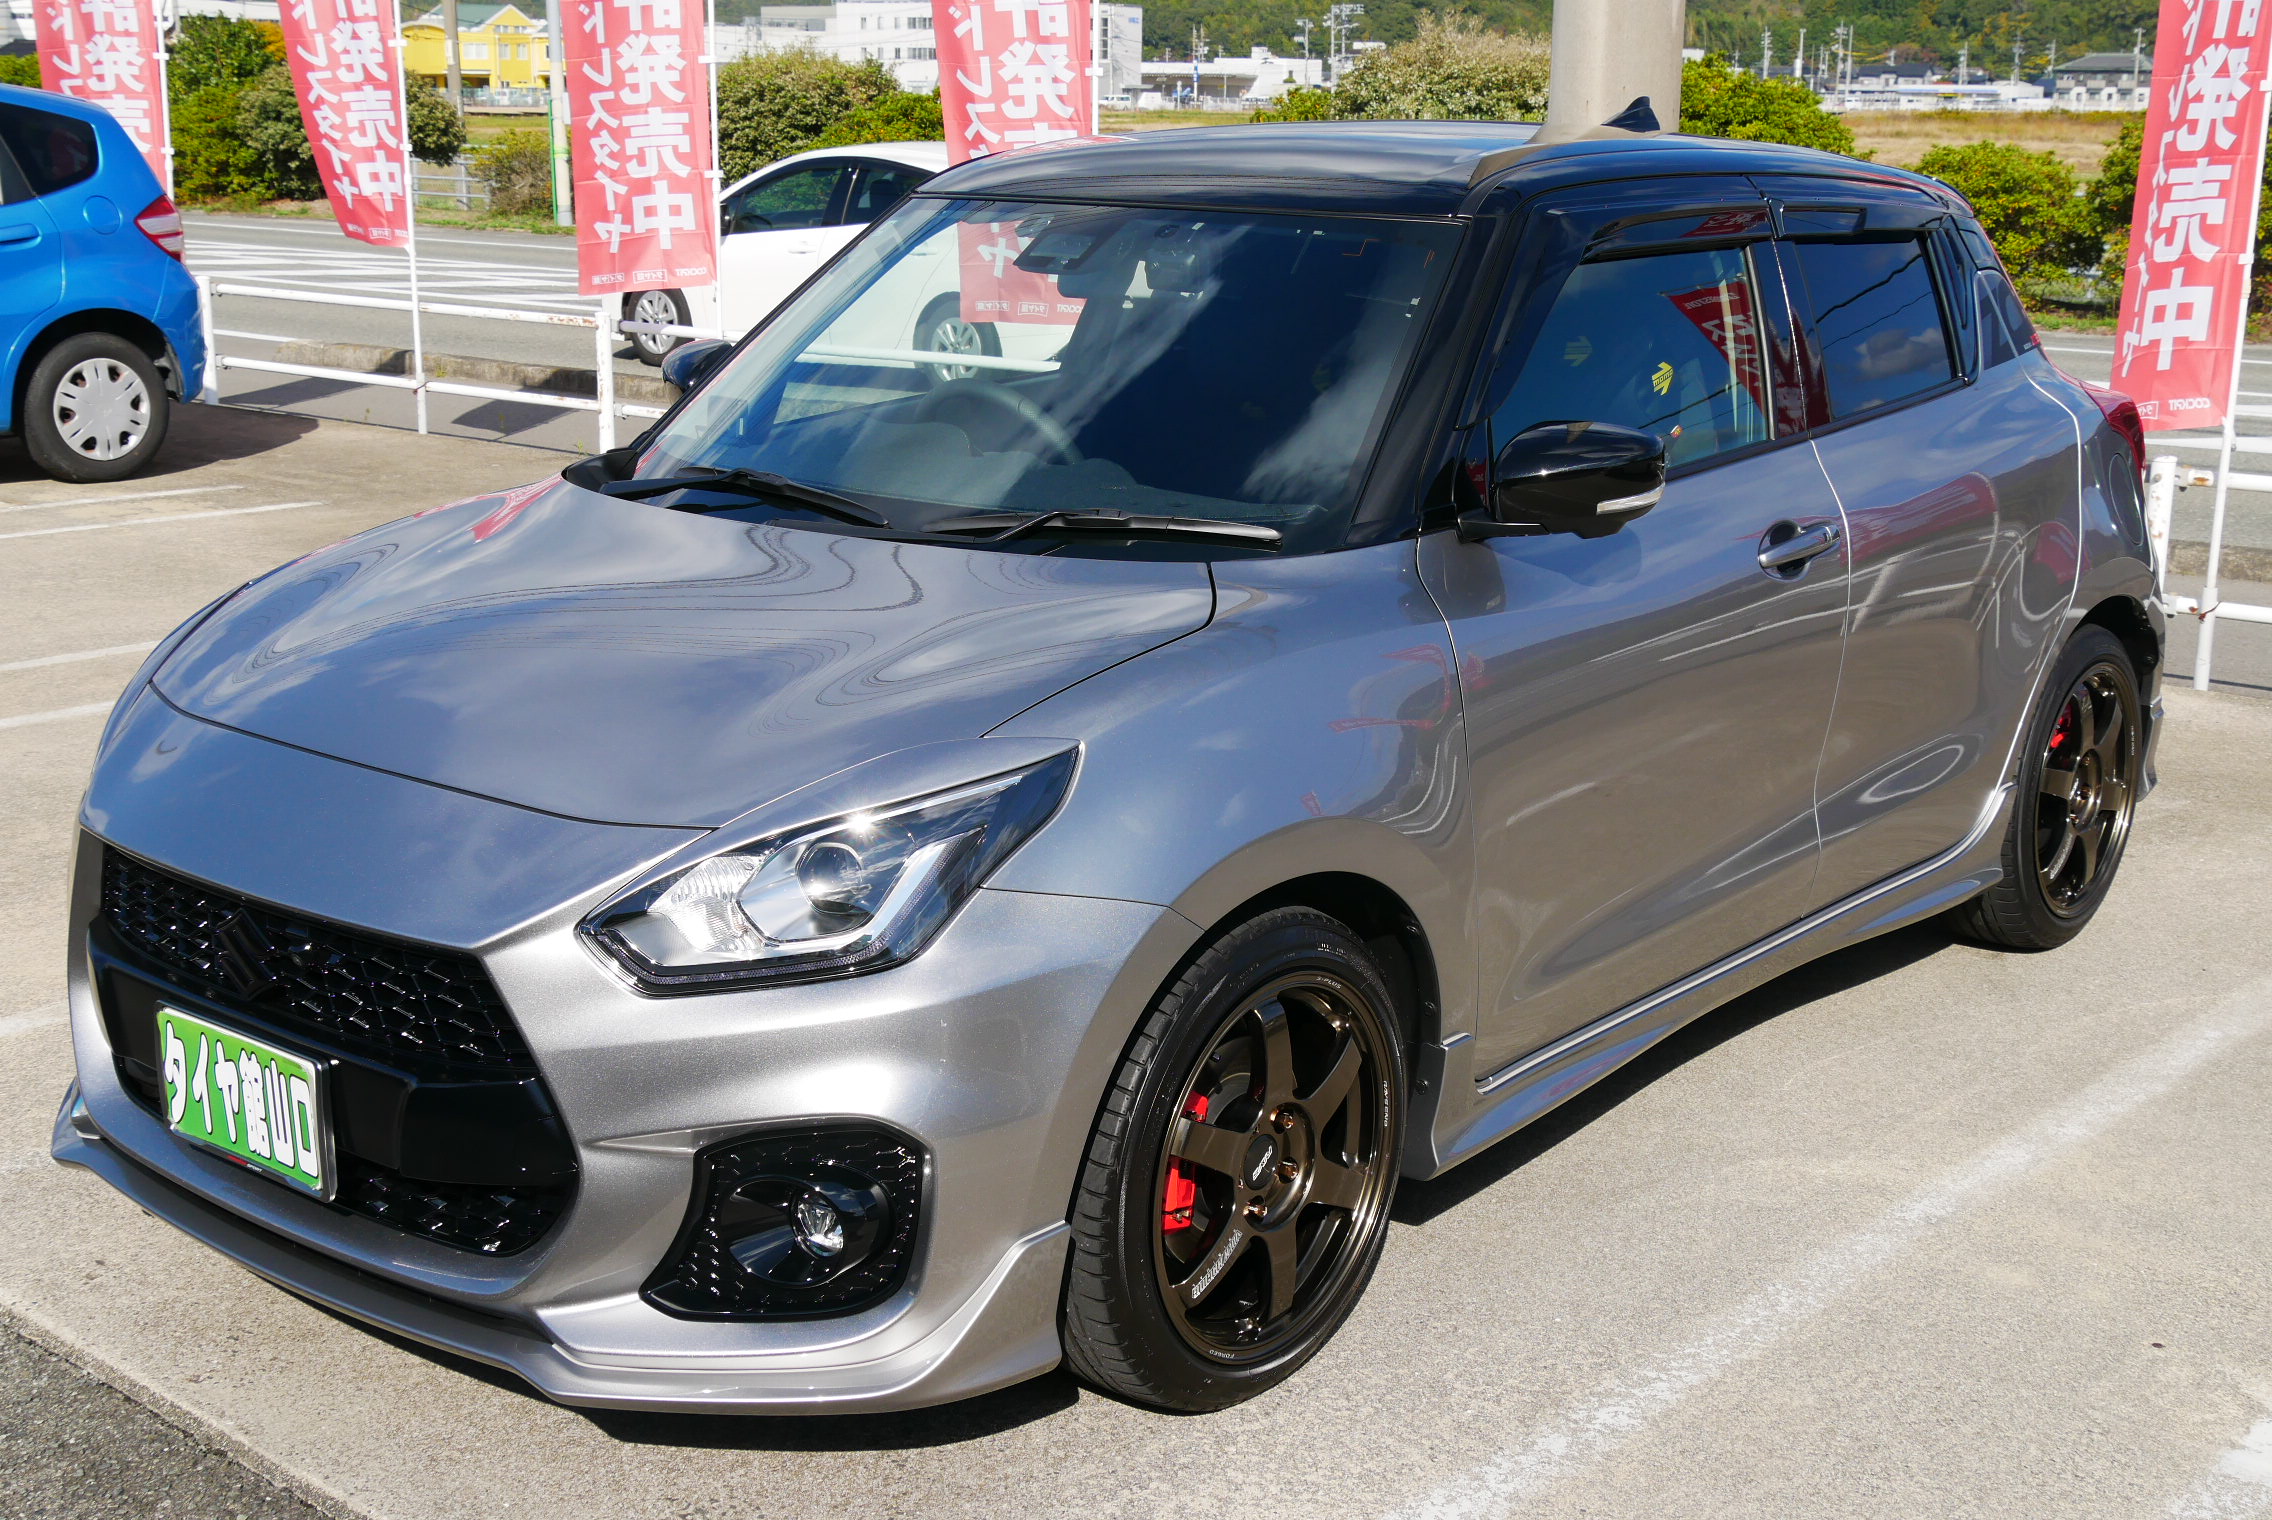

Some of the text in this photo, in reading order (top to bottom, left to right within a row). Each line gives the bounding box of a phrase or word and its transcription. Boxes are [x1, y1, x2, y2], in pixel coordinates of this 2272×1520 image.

[164, 1019, 319, 1178] タイヤ館山口
